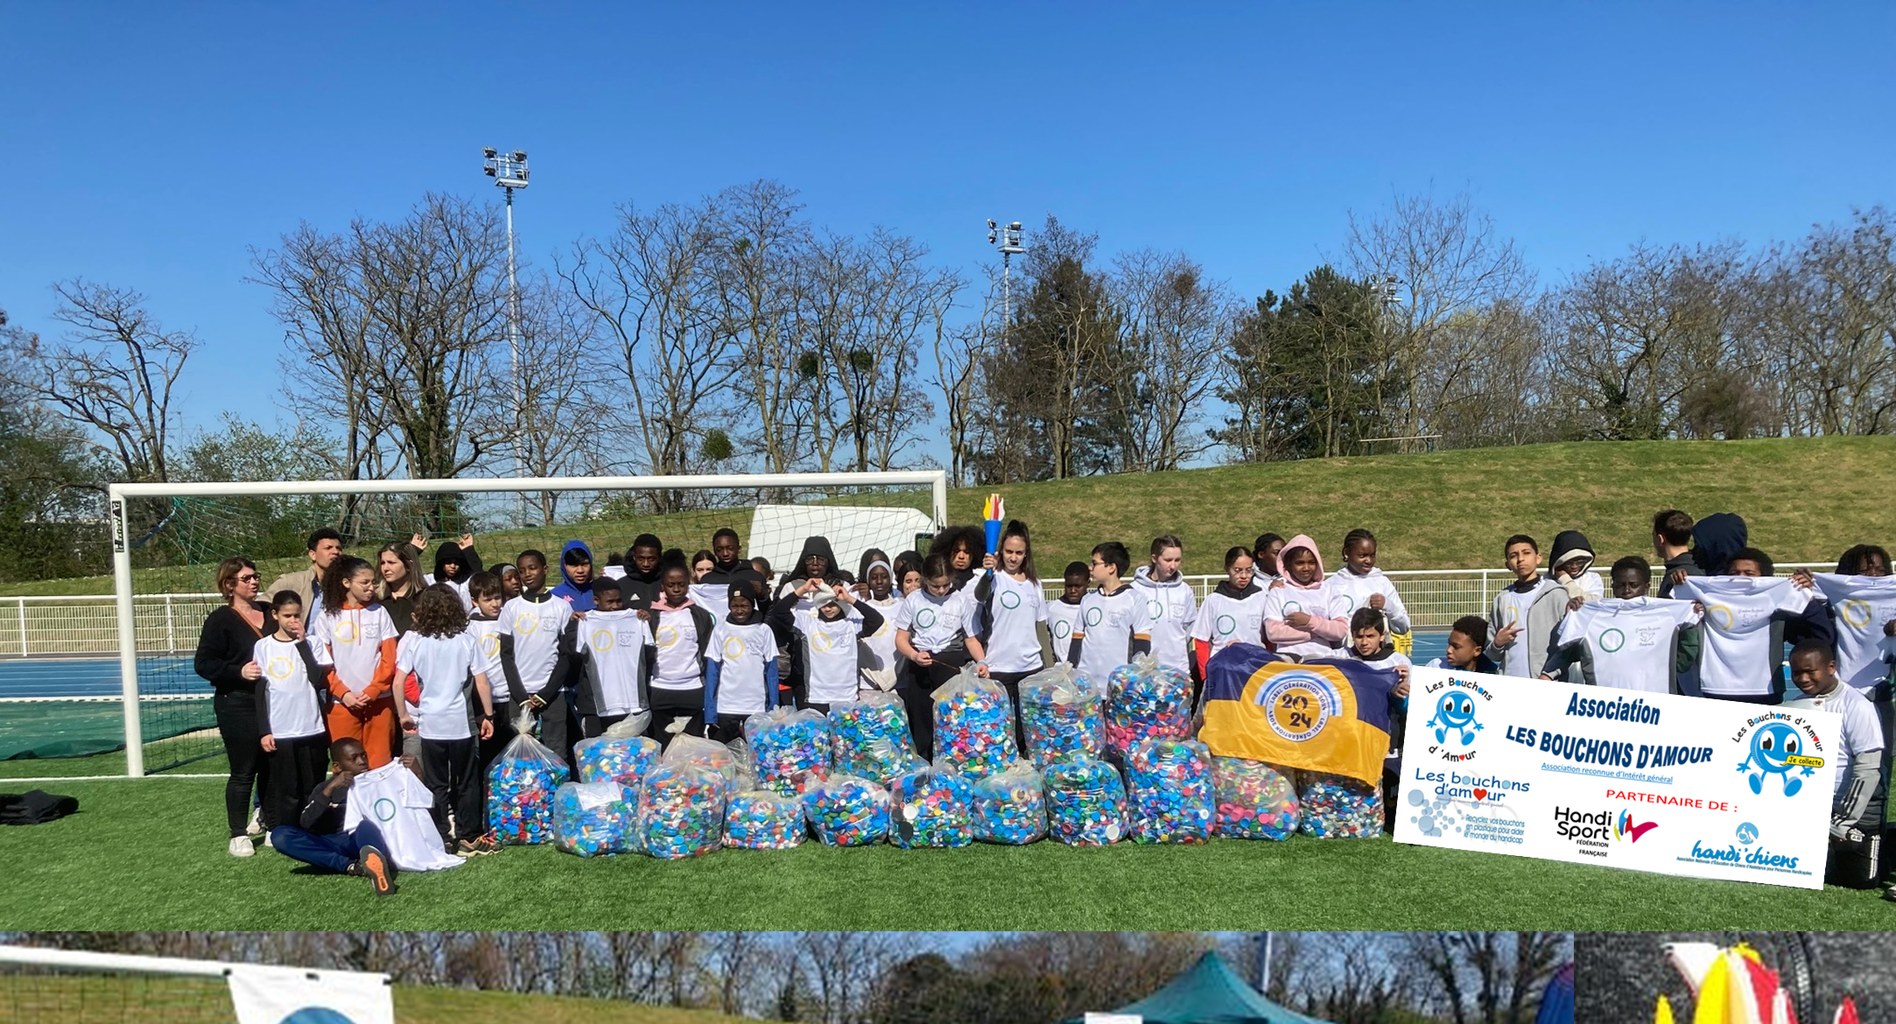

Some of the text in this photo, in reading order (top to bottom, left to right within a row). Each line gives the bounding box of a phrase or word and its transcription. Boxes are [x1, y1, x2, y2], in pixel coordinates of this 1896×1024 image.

[1425, 677, 1493, 701] Les Bouchons
[1281, 693, 1308, 711] 20
[1565, 692, 1661, 726] Association
[1289, 711, 1312, 728] 24
[1732, 726, 1747, 743] Les
[1747, 711, 1792, 727] Bouchons
[1505, 725, 1713, 769] LES BOUCHONS D'AMOUR
[1798, 757, 1822, 766] collecte
[1415, 767, 1530, 792] Les bouchons
[1541, 762, 1580, 774] Association
[1582, 767, 1615, 778] reconnue
[1646, 773, 1674, 785] général
[1606, 789, 1703, 809] PARTENAIRE
[1708, 800, 1729, 812] DE
[1554, 806, 1613, 826] Handi
[1556, 821, 1610, 841] Sport
[1576, 839, 1609, 848] FÉDÉRATION
[1579, 849, 1608, 858] FRANÇAISE
